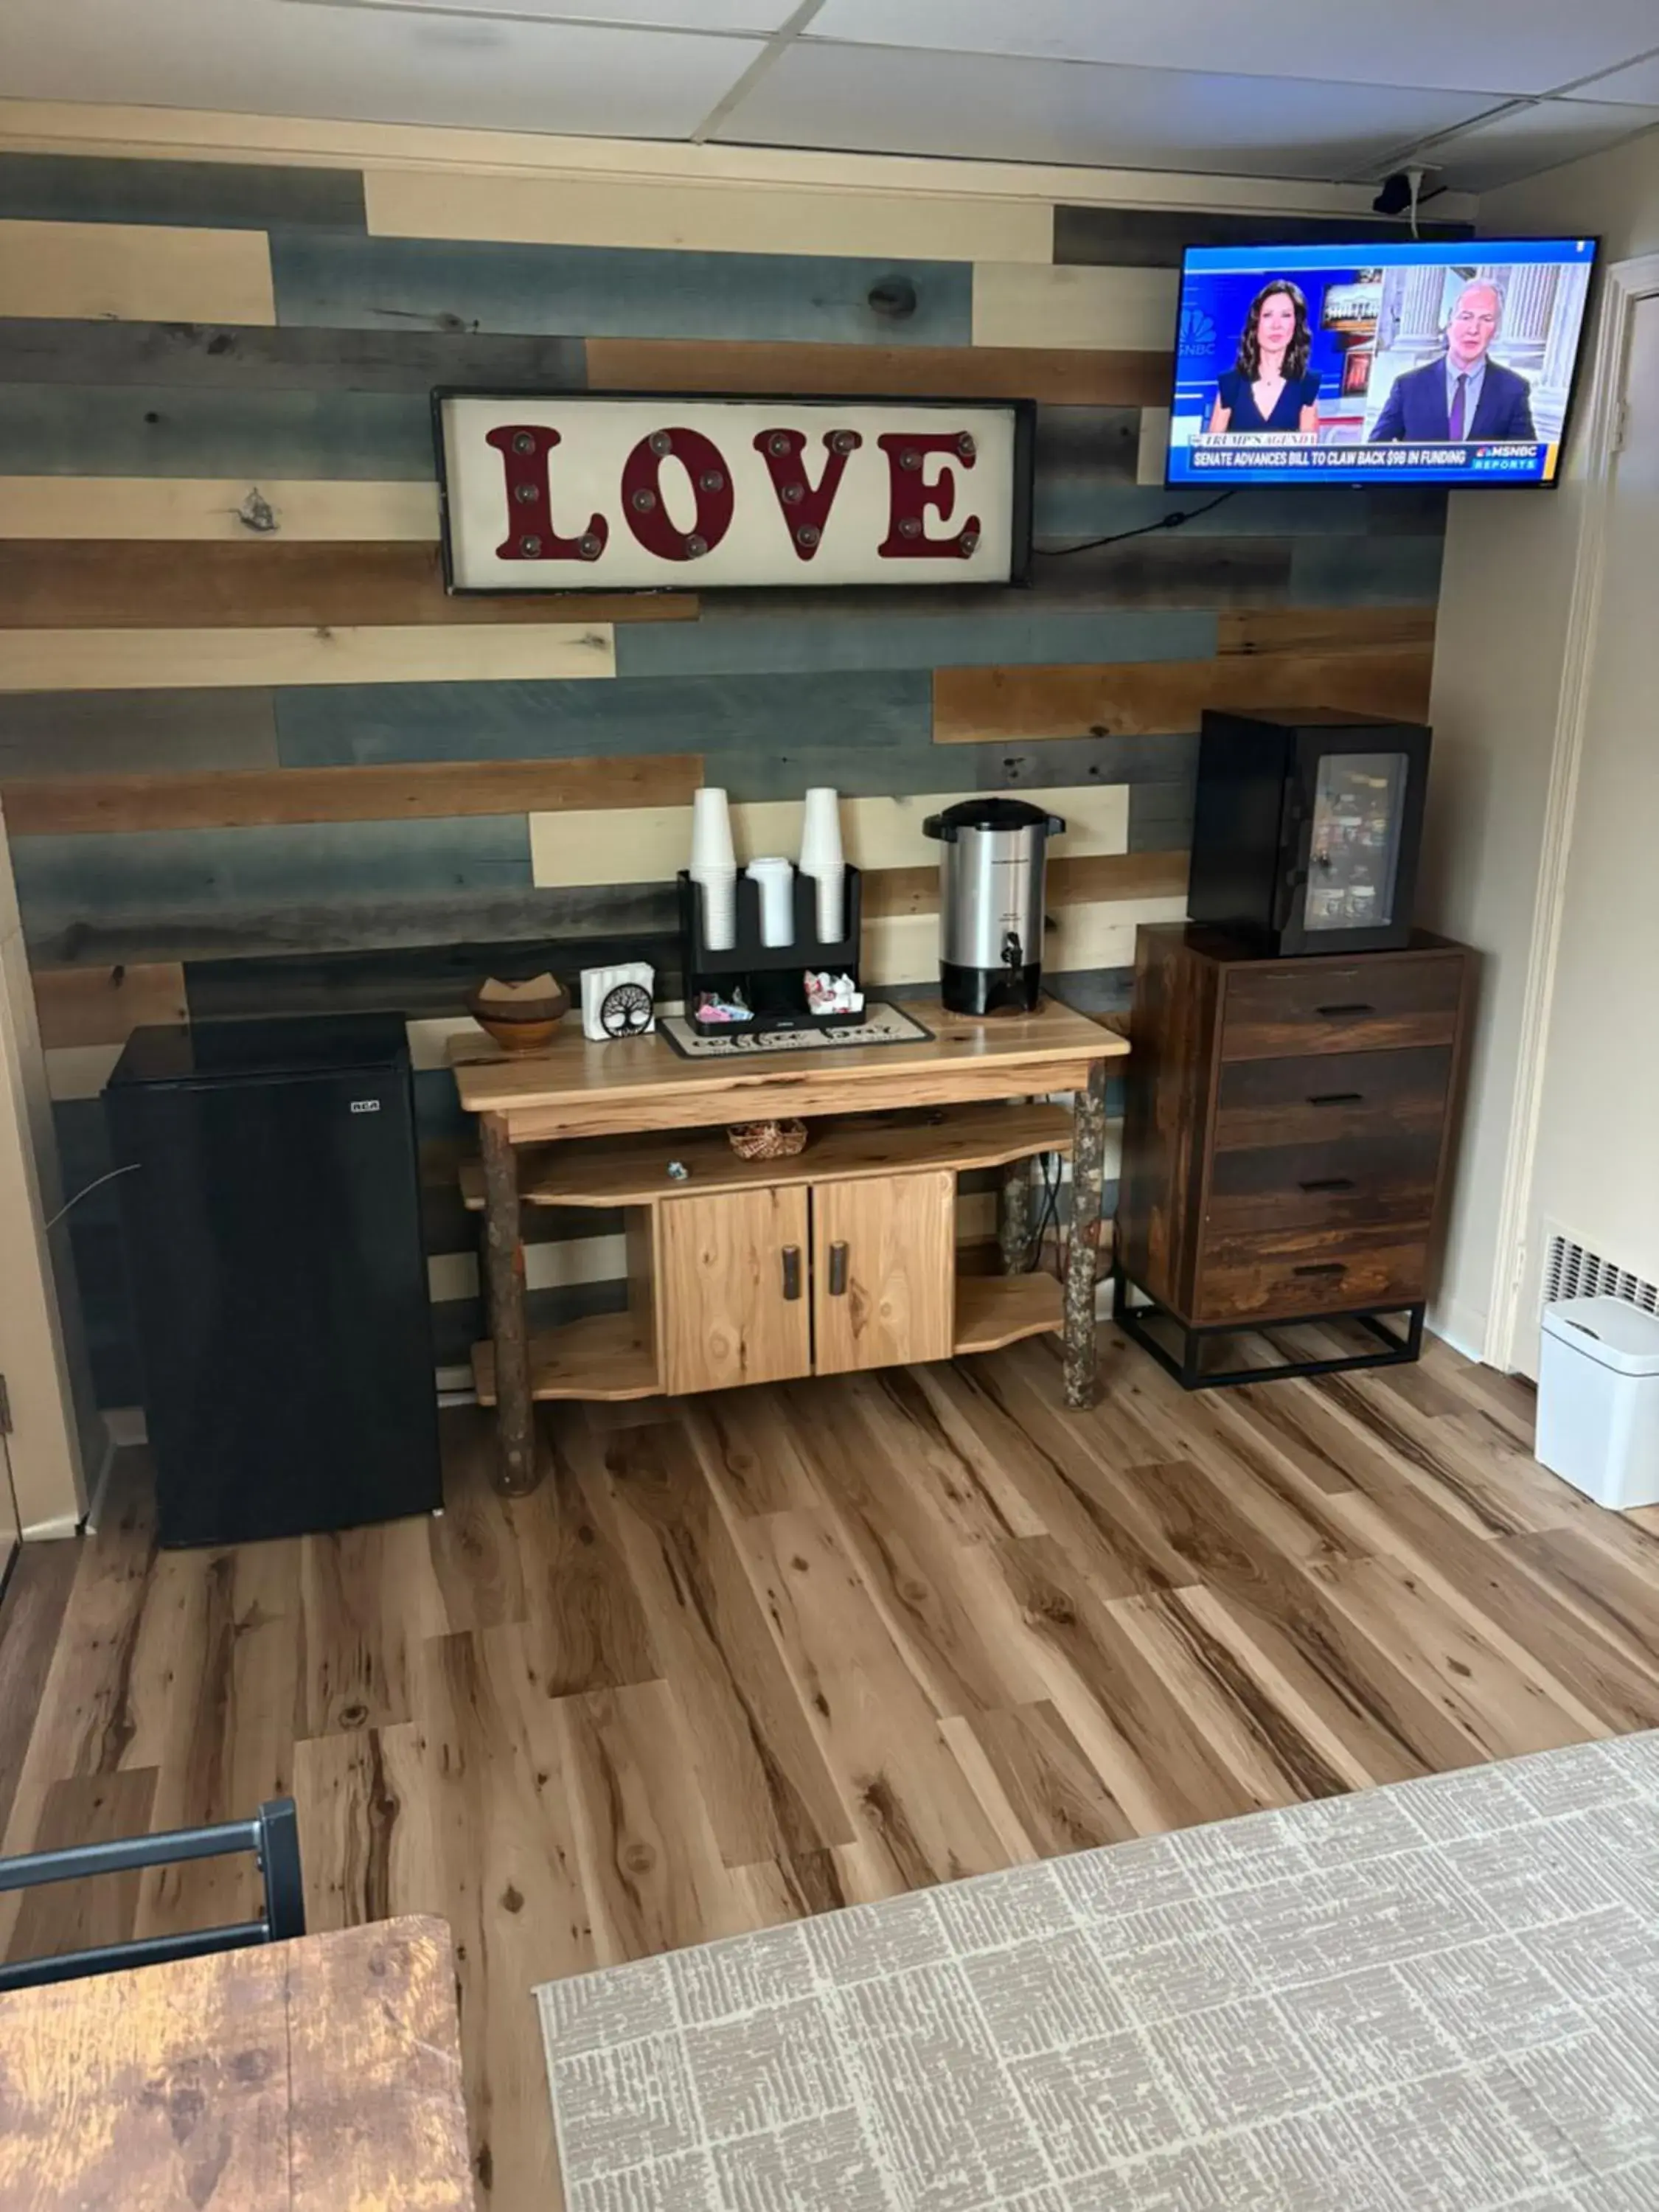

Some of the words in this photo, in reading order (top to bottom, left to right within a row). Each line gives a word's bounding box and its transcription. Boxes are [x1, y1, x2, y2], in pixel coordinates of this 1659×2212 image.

[1194, 451, 1233, 466] SENATE
[1234, 451, 1287, 466] ADVANCES
[1288, 451, 1310, 466] BILL
[1312, 451, 1326, 465] TO
[1327, 451, 1355, 465] CLAW
[1357, 451, 1385, 465] BACK
[1386, 450, 1406, 465] $9B
[1408, 451, 1420, 465] IN
[1421, 450, 1466, 465] FUNDING
[1492, 445, 1537, 457] MSNBC
[1474, 459, 1535, 470] REPORTS
[485, 425, 981, 562] LOVE
